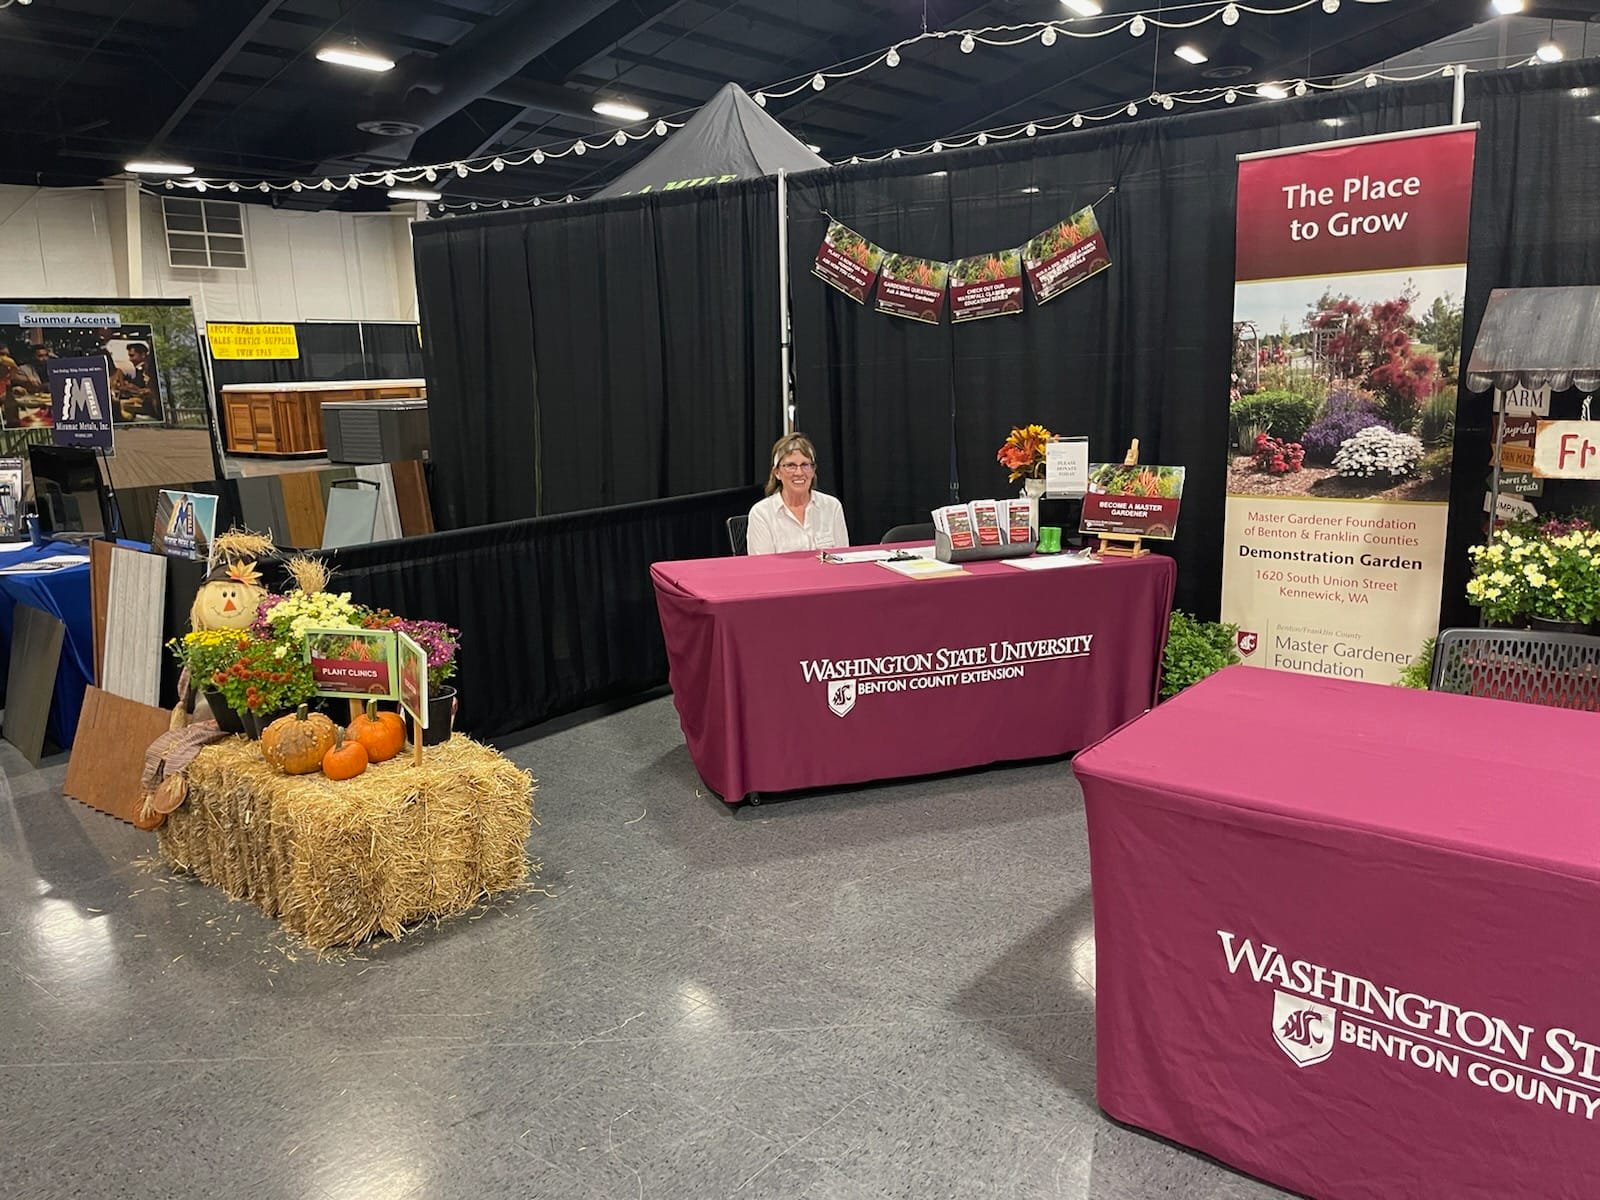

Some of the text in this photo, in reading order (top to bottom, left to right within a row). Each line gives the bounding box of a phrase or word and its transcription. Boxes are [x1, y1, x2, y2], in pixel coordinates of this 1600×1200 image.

[1281, 175, 1421, 209] The Place
[1289, 211, 1409, 241] to Grow
[883, 281, 911, 292] GARDENING
[966, 287, 983, 295] CHECK
[23, 315, 117, 325] Summer Accents
[84, 381, 99, 416] METALS
[1507, 388, 1543, 408] ARM
[99, 422, 110, 430] Inc.
[1502, 422, 1535, 438] ayrides
[1558, 434, 1596, 470] Fr
[1515, 481, 1539, 493] treats
[1099, 501, 1128, 509] BECOME
[1134, 503, 1163, 512] MASTER
[1111, 509, 1148, 518] GARDENER
[1248, 511, 1417, 530] Master Gardener Foundation
[1244, 527, 1419, 547] of Benton & Franklin Counties
[1239, 545, 1423, 570] Demonstration Garden
[1256, 570, 1398, 591] 1620 South Union Street
[1279, 586, 1369, 604] Kennewick, WA
[1335, 630, 1363, 641] County
[800, 634, 1094, 683] WASHINGTON STATE UNIVERSITY
[1275, 635, 1413, 665] Master Gardener
[322, 667, 378, 678] PLANT CLINICS
[1274, 655, 1364, 679] Foundation
[858, 665, 1025, 695] BENTON COUNTY EXTENSION
[1217, 930, 1600, 1081] WASHINGTON ST
[1340, 1019, 1600, 1120] BENTON COUNTY
